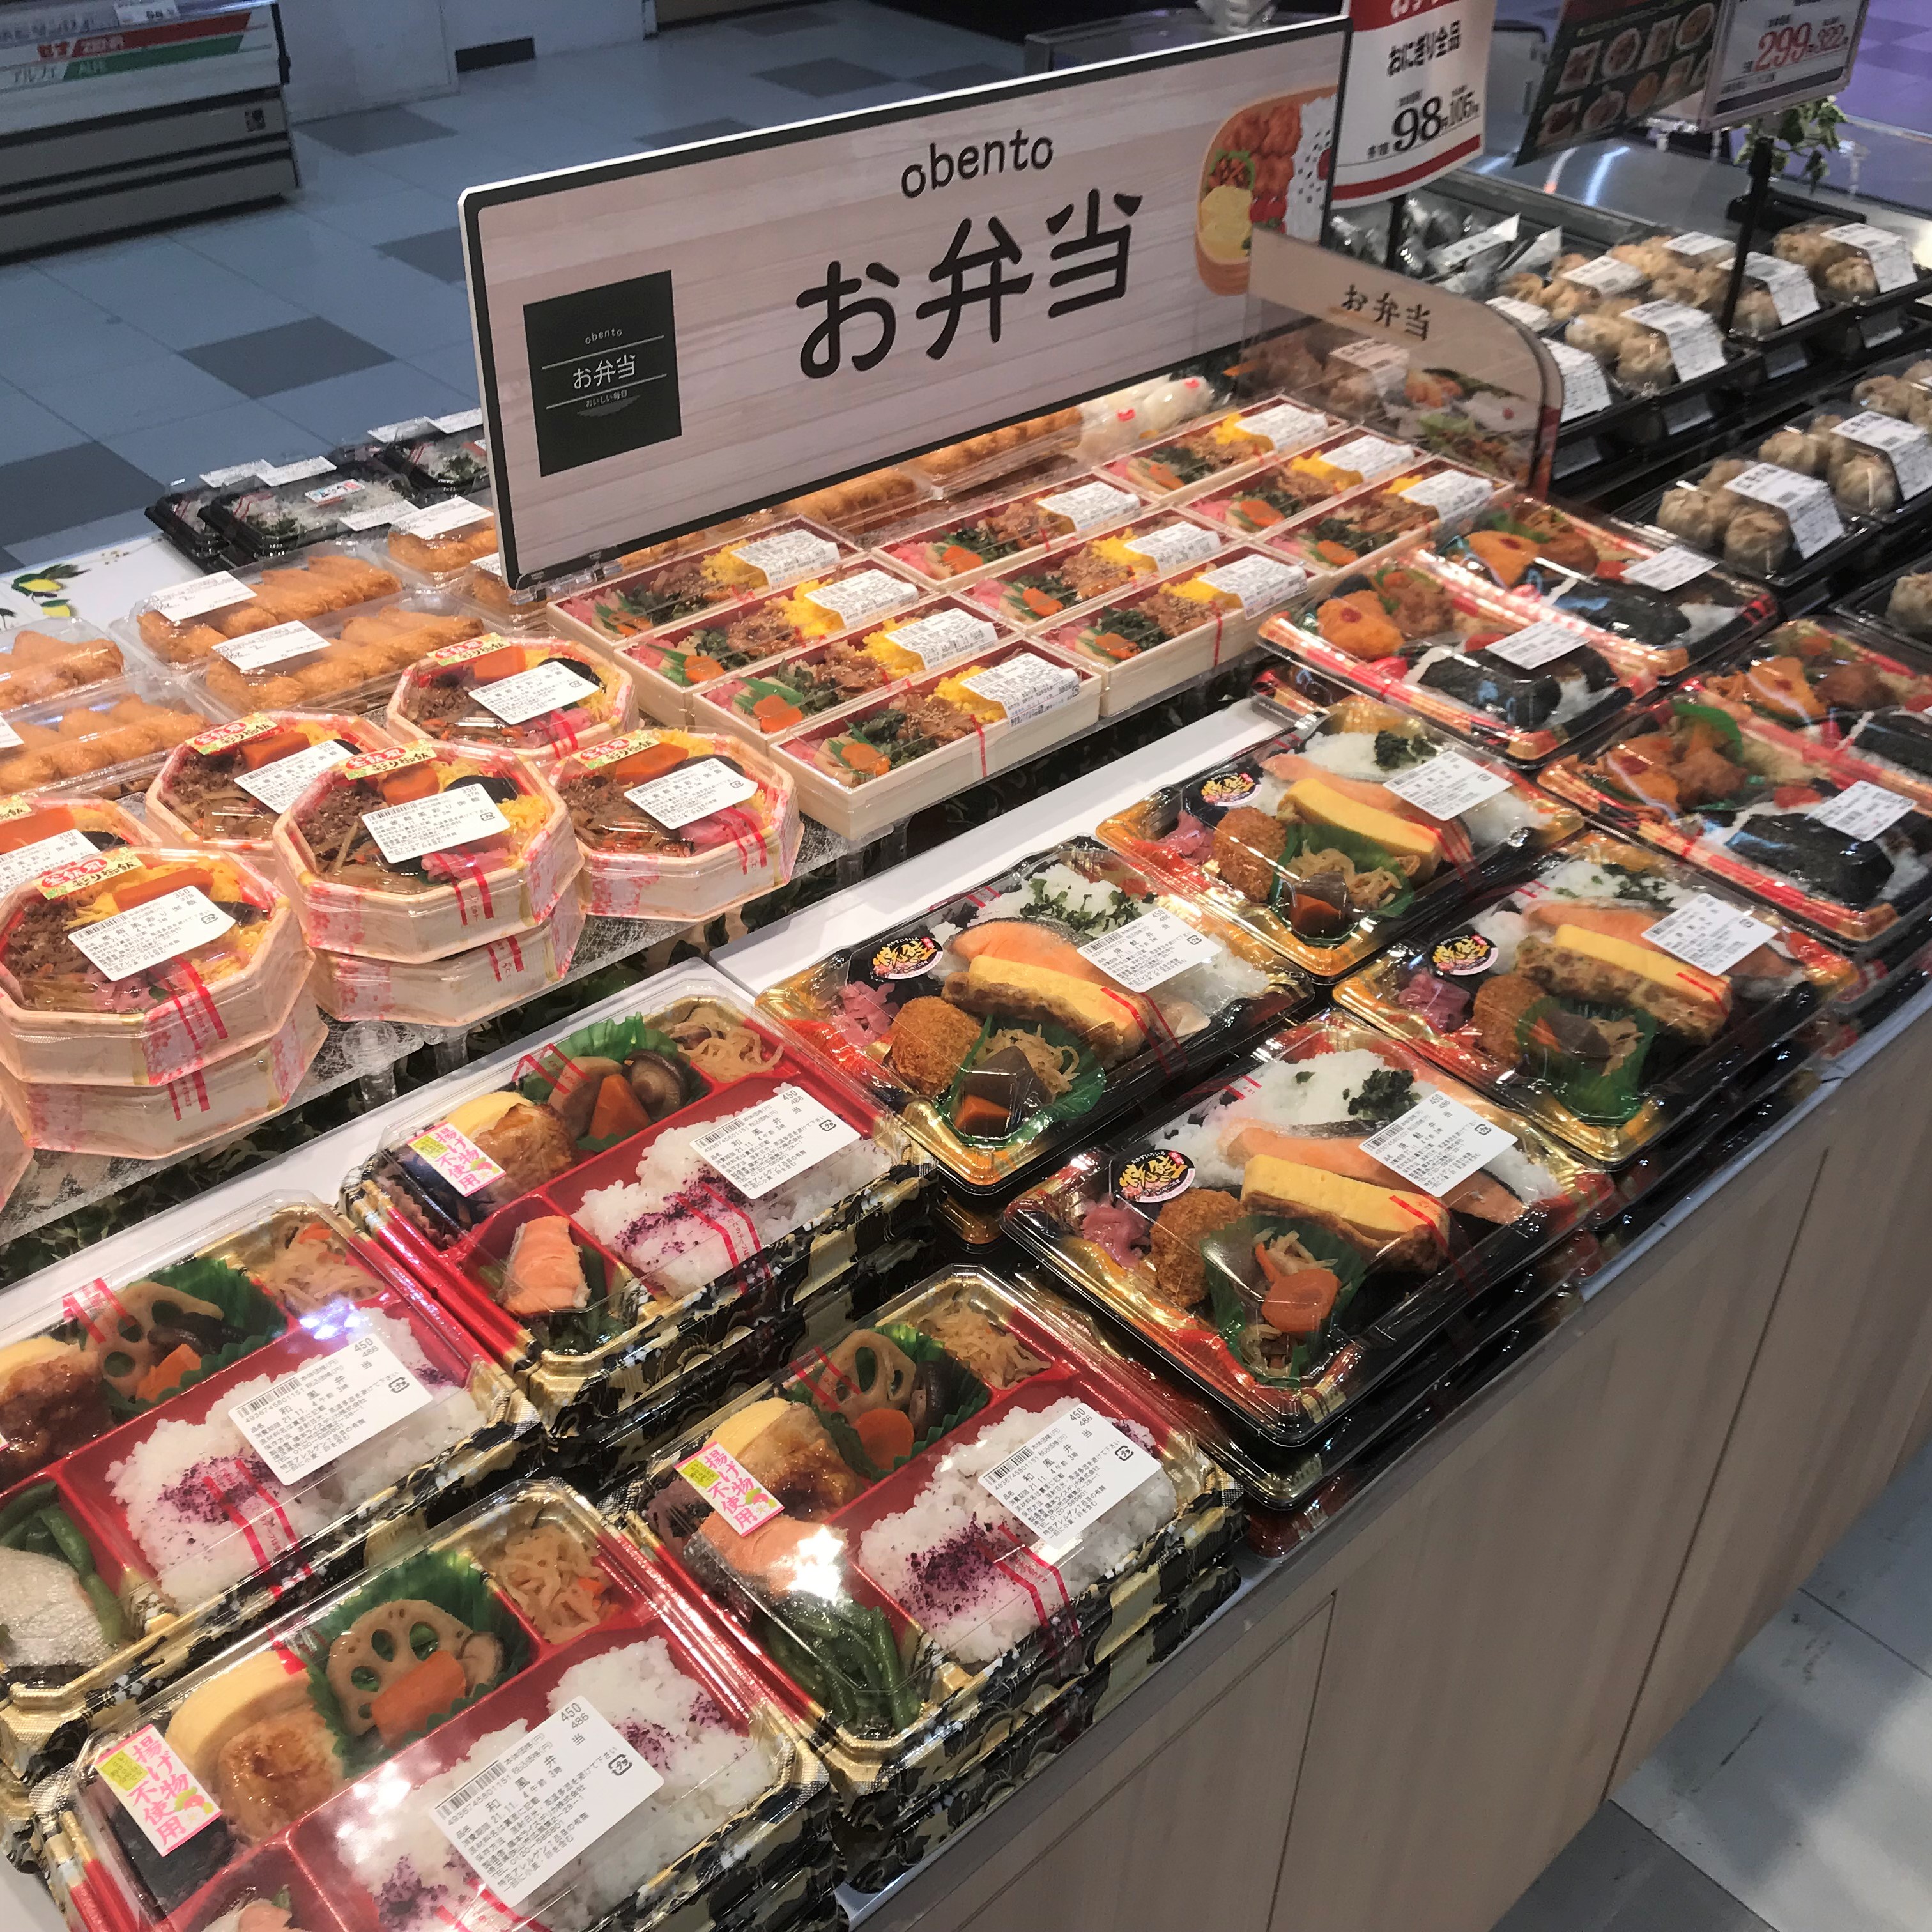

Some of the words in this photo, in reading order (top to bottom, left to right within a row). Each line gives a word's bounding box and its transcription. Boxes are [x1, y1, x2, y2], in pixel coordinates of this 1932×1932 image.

[900, 129, 1054, 199] obento
[795, 188, 1143, 379] お弁当
[1341, 284, 1431, 341] お弁当
[585, 328, 623, 344] obento
[572, 354, 636, 389] お弁当
[586, 389, 628, 408] おいしい毎日
[172, 889, 190, 898] 350
[781, 1090, 797, 1100] 450
[1428, 1094, 1443, 1105] 450
[434, 1128, 480, 1163] 揚げ物
[434, 1154, 481, 1189] 不使用
[353, 1338, 372, 1351] 450
[362, 1346, 378, 1357] 486
[1068, 1408, 1085, 1421] 450
[1078, 1415, 1092, 1426] 486
[704, 1450, 755, 1498] 揚げ物
[1002, 1490, 1015, 1499] 品名
[707, 1483, 758, 1529] 不使用
[1037, 1519, 1049, 1529] TEL
[558, 1703, 581, 1722] 450
[570, 1713, 588, 1729] 486
[132, 1735, 190, 1802] 揚げ物
[126, 1782, 185, 1846] 不使用
[455, 1825, 471, 1839] 品名
[491, 1865, 507, 1880] TEL
